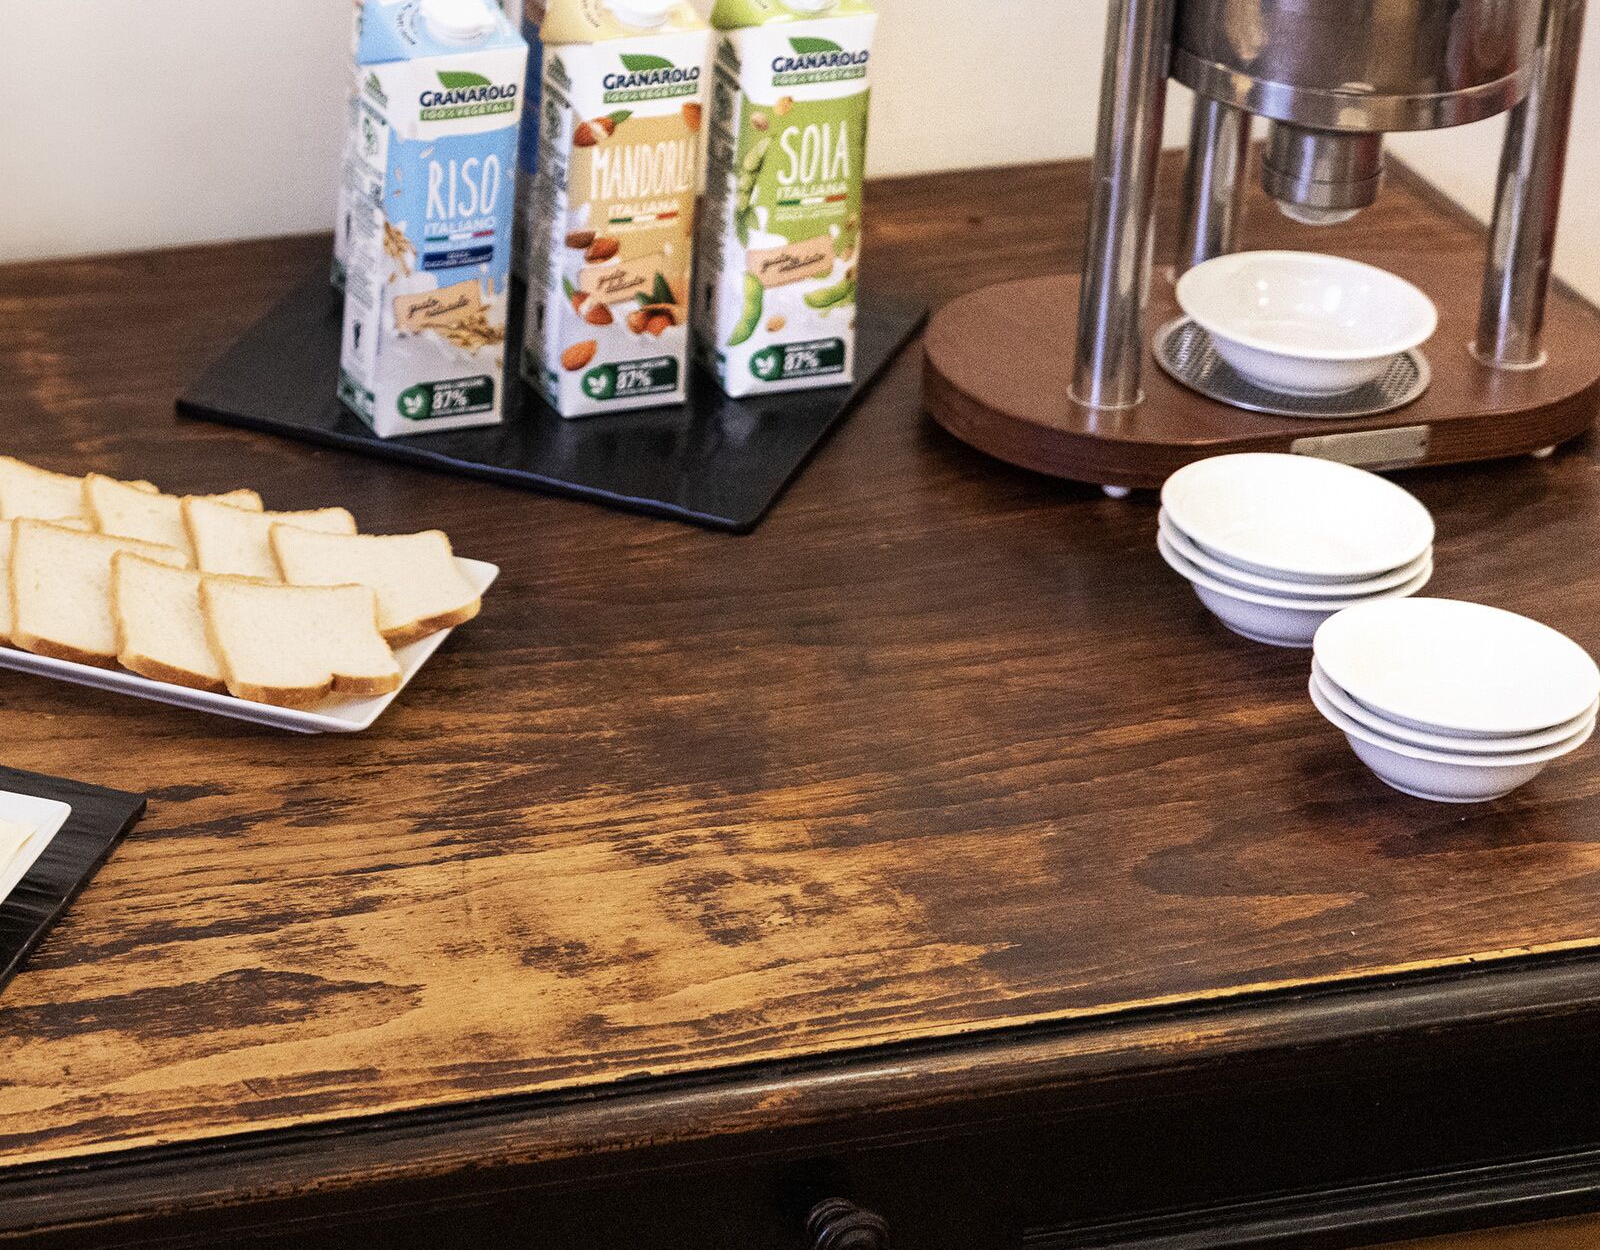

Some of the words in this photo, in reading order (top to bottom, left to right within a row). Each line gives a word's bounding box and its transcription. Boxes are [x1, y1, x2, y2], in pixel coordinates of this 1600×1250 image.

[772, 49, 870, 73] GRANAROLO
[603, 66, 700, 90] GRANAROLO
[420, 83, 517, 107] GRANAROLO
[776, 120, 849, 185] SOIA
[426, 153, 500, 221] RISO
[424, 216, 495, 235] ITALIANO
[783, 351, 820, 371] 87%
[615, 369, 653, 390] 87%
[431, 389, 469, 410] 87%
